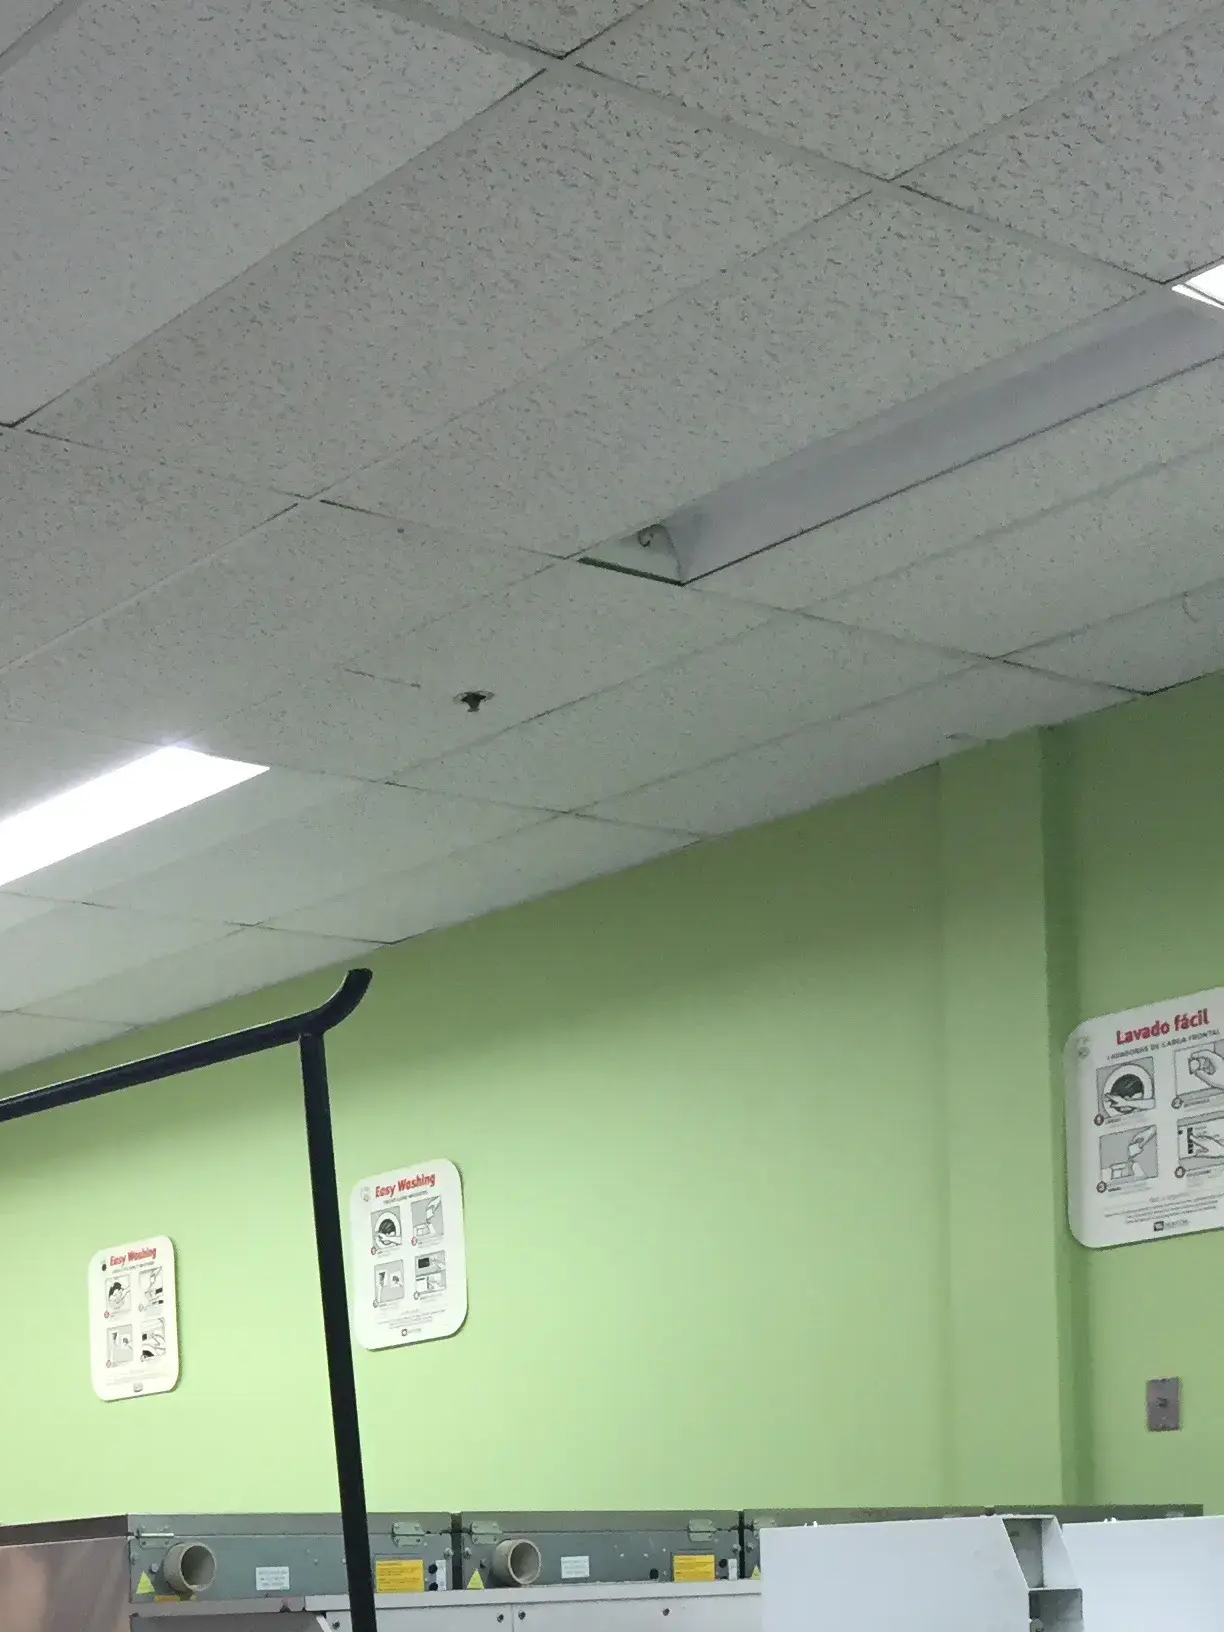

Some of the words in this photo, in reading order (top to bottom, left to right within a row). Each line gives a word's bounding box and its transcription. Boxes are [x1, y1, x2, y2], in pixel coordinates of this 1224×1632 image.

[1116, 1020, 1170, 1045] Lavado
[1174, 1007, 1210, 1031] fácil
[375, 1185, 396, 1198] Easy
[397, 1173, 436, 1191] Washing
